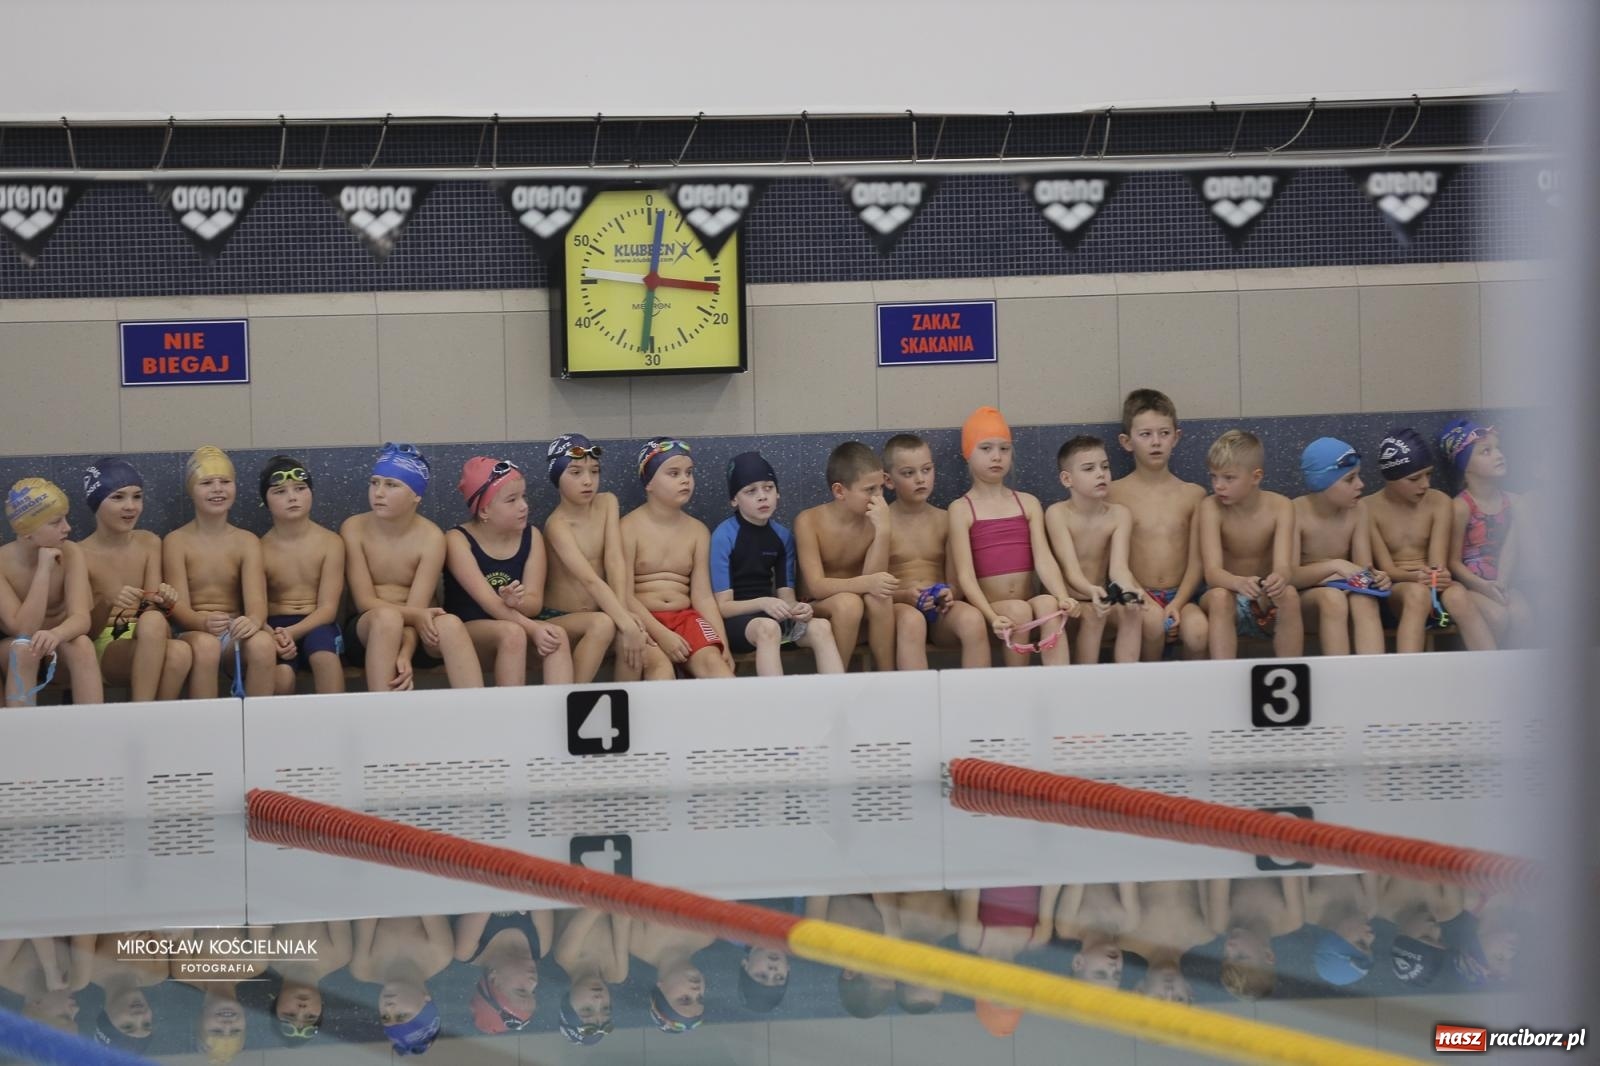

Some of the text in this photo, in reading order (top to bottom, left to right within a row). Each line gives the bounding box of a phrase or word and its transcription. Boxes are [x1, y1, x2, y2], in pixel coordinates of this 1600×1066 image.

[852, 182, 922, 207] arena
[1034, 179, 1104, 204] arena
[1203, 175, 1273, 199] arena
[1367, 171, 1438, 195] arena
[172, 186, 244, 211] arena
[340, 186, 412, 211] arena
[512, 185, 583, 210] arena
[645, 195, 653, 206] 0
[678, 183, 749, 209] arena
[574, 235, 589, 247] 50
[575, 317, 591, 329] 40
[713, 313, 729, 325] 20
[912, 313, 961, 331] ZAKAZ
[164, 332, 205, 350] NIE
[900, 335, 974, 354] SKAKANIA
[142, 355, 230, 375] BIEGAJ
[644, 354, 661, 366] 30
[1262, 668, 1300, 723] 3
[577, 693, 620, 751] 4
